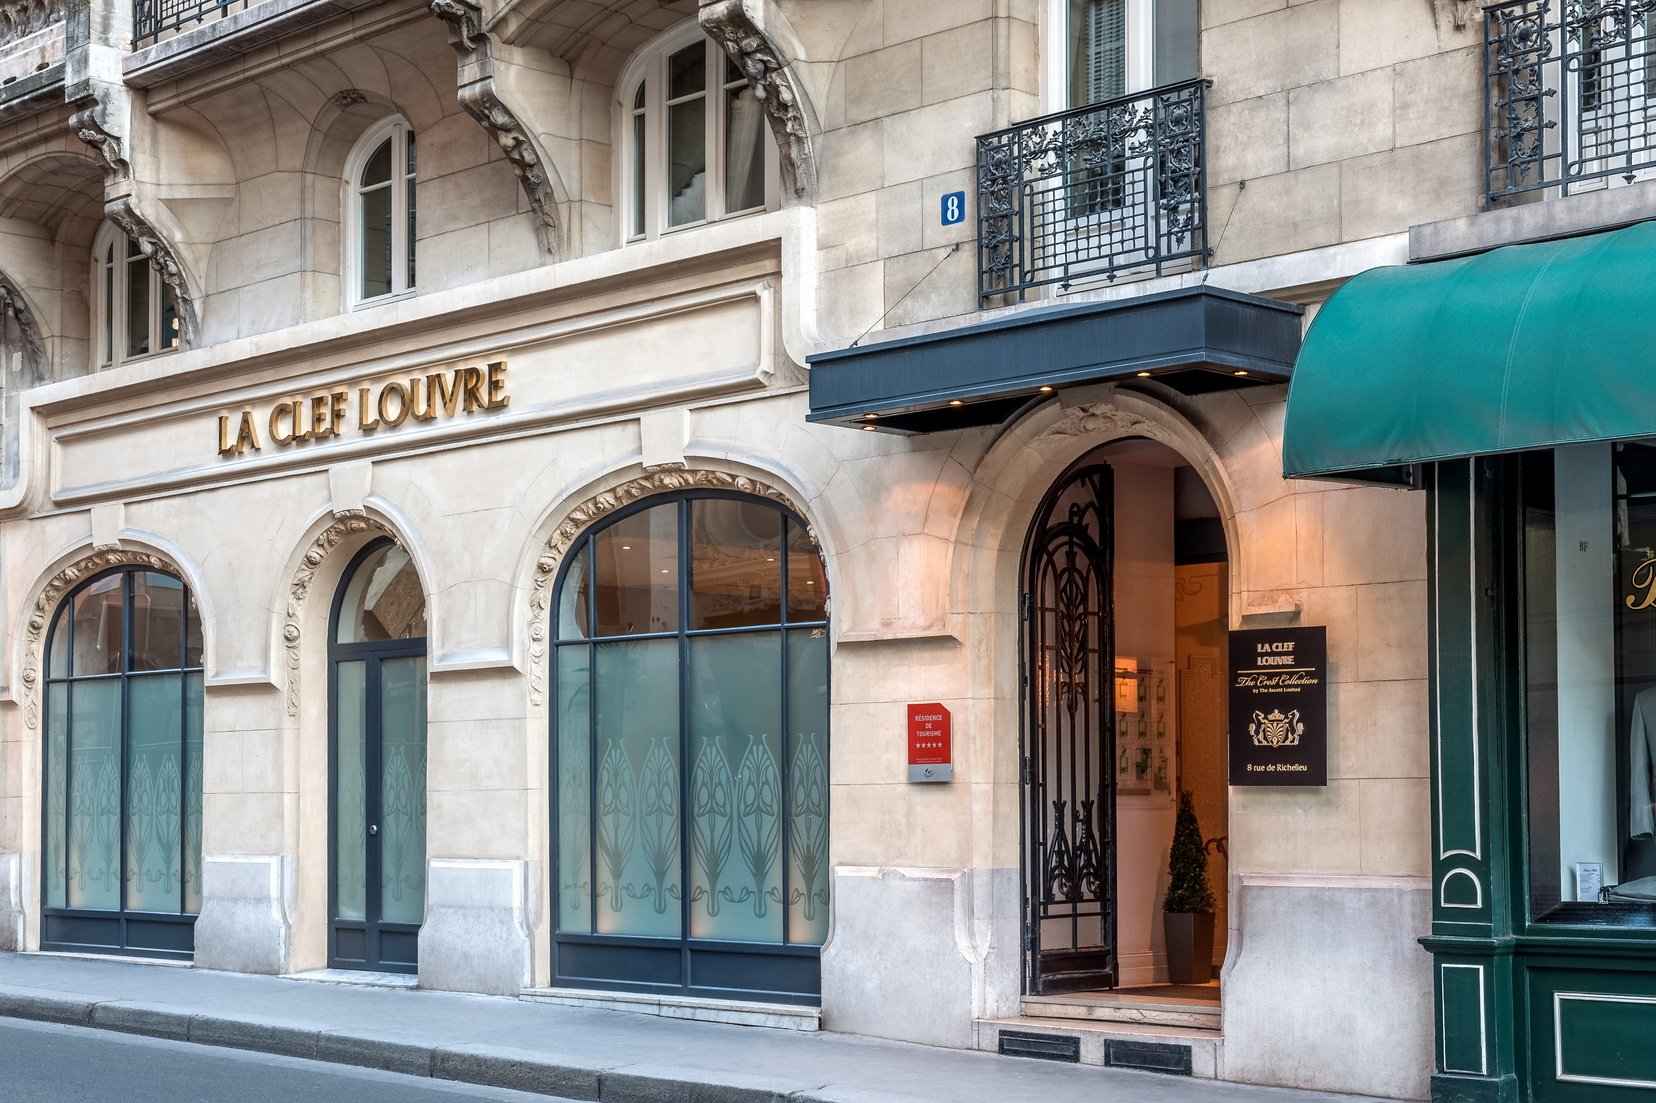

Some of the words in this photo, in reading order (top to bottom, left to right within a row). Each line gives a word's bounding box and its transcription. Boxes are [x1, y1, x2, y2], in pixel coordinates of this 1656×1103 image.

[947, 196, 959, 220] 8
[217, 410, 262, 456] LA
[269, 392, 349, 446] CLEF
[358, 361, 510, 431] LOUVRE
[1257, 643, 1271, 652] LA
[1272, 642, 1295, 651] CLEF
[1257, 656, 1295, 665] LOUVRE
[1235, 674, 1258, 687] The
[1258, 674, 1280, 687] Crest
[1279, 671, 1318, 686] Collection
[1247, 763, 1253, 771] 8
[1266, 763, 1276, 771] de
[1276, 763, 1308, 771] Richelieu
